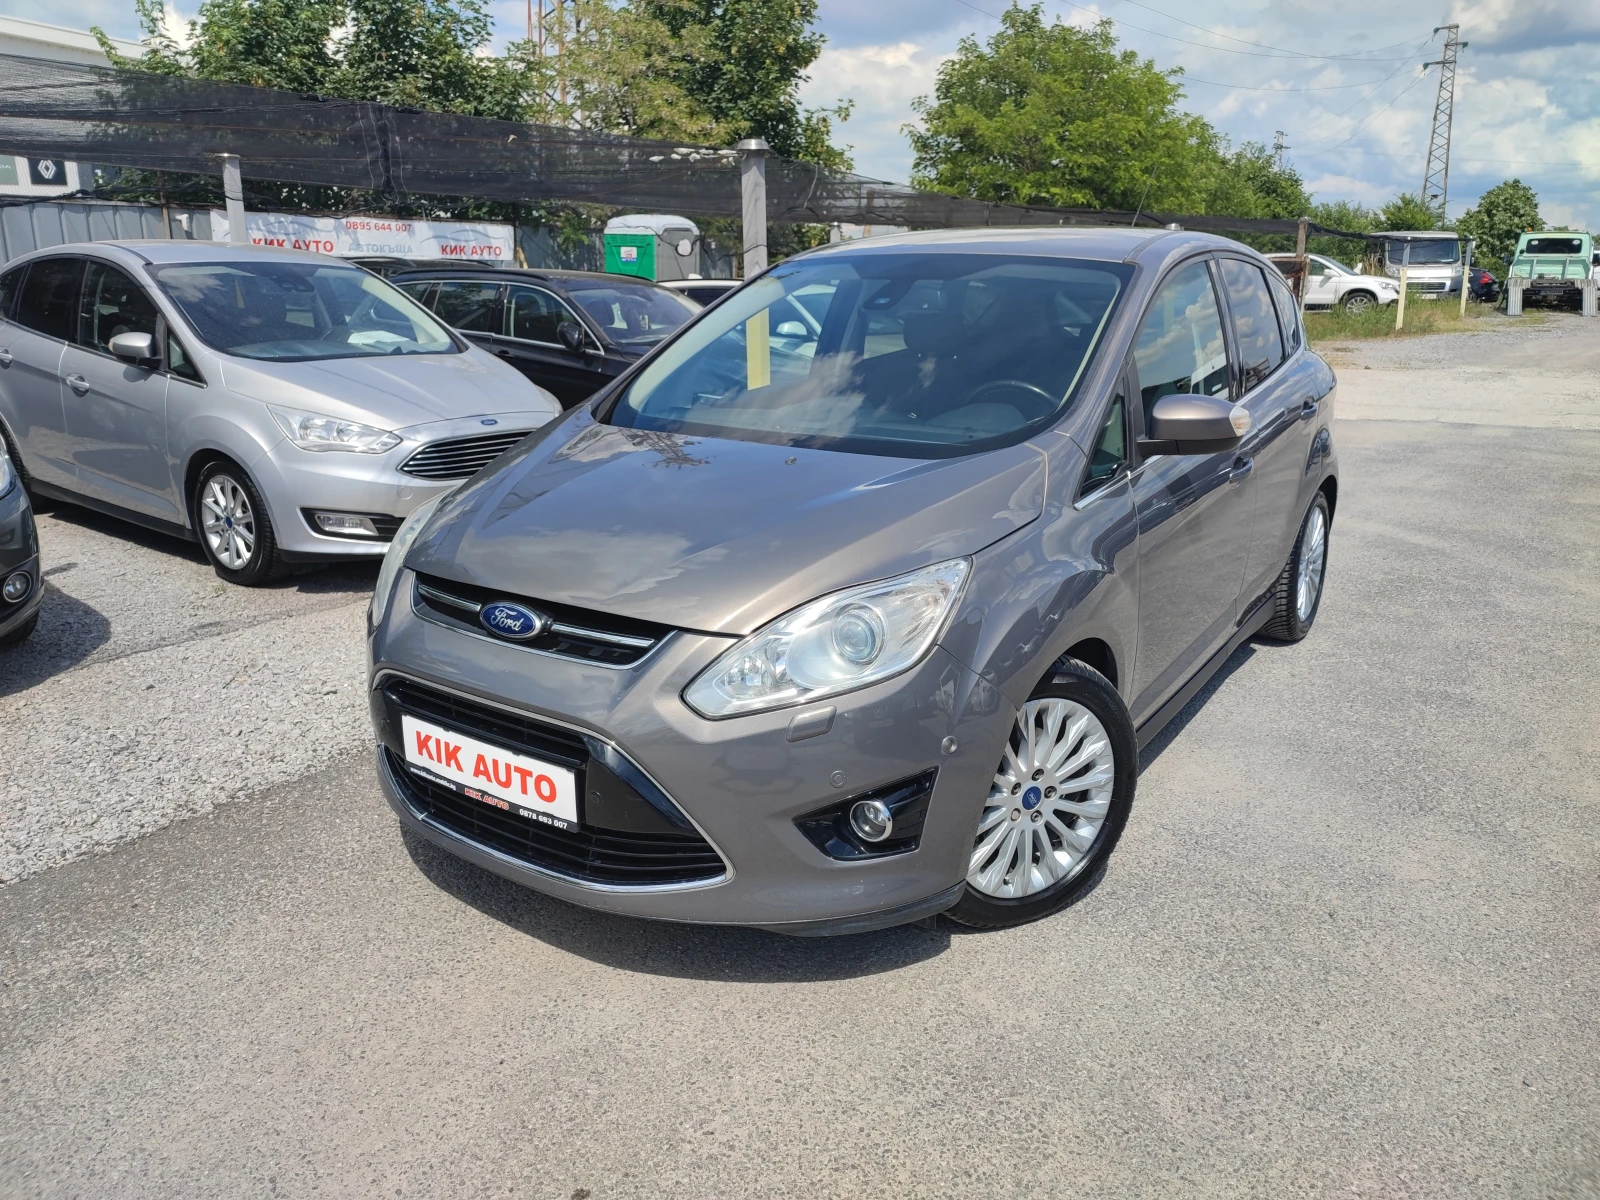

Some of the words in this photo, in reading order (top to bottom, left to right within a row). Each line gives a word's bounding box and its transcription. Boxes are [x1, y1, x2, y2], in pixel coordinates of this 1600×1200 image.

[345, 221, 371, 231] 0895
[374, 223, 392, 232] 644
[395, 224, 412, 232] 007
[348, 243, 413, 254] АВТОКЪЩА
[441, 245, 466, 256] КИК
[471, 246, 502, 257] АУТО
[490, 607, 525, 632] Ford
[416, 730, 464, 773] KIK
[473, 753, 557, 804] AUTO
[464, 787, 482, 801] KIK
[482, 795, 510, 811] AUTO
[519, 808, 538, 820] 0878
[538, 815, 553, 825] 693
[553, 819, 568, 830] 007
